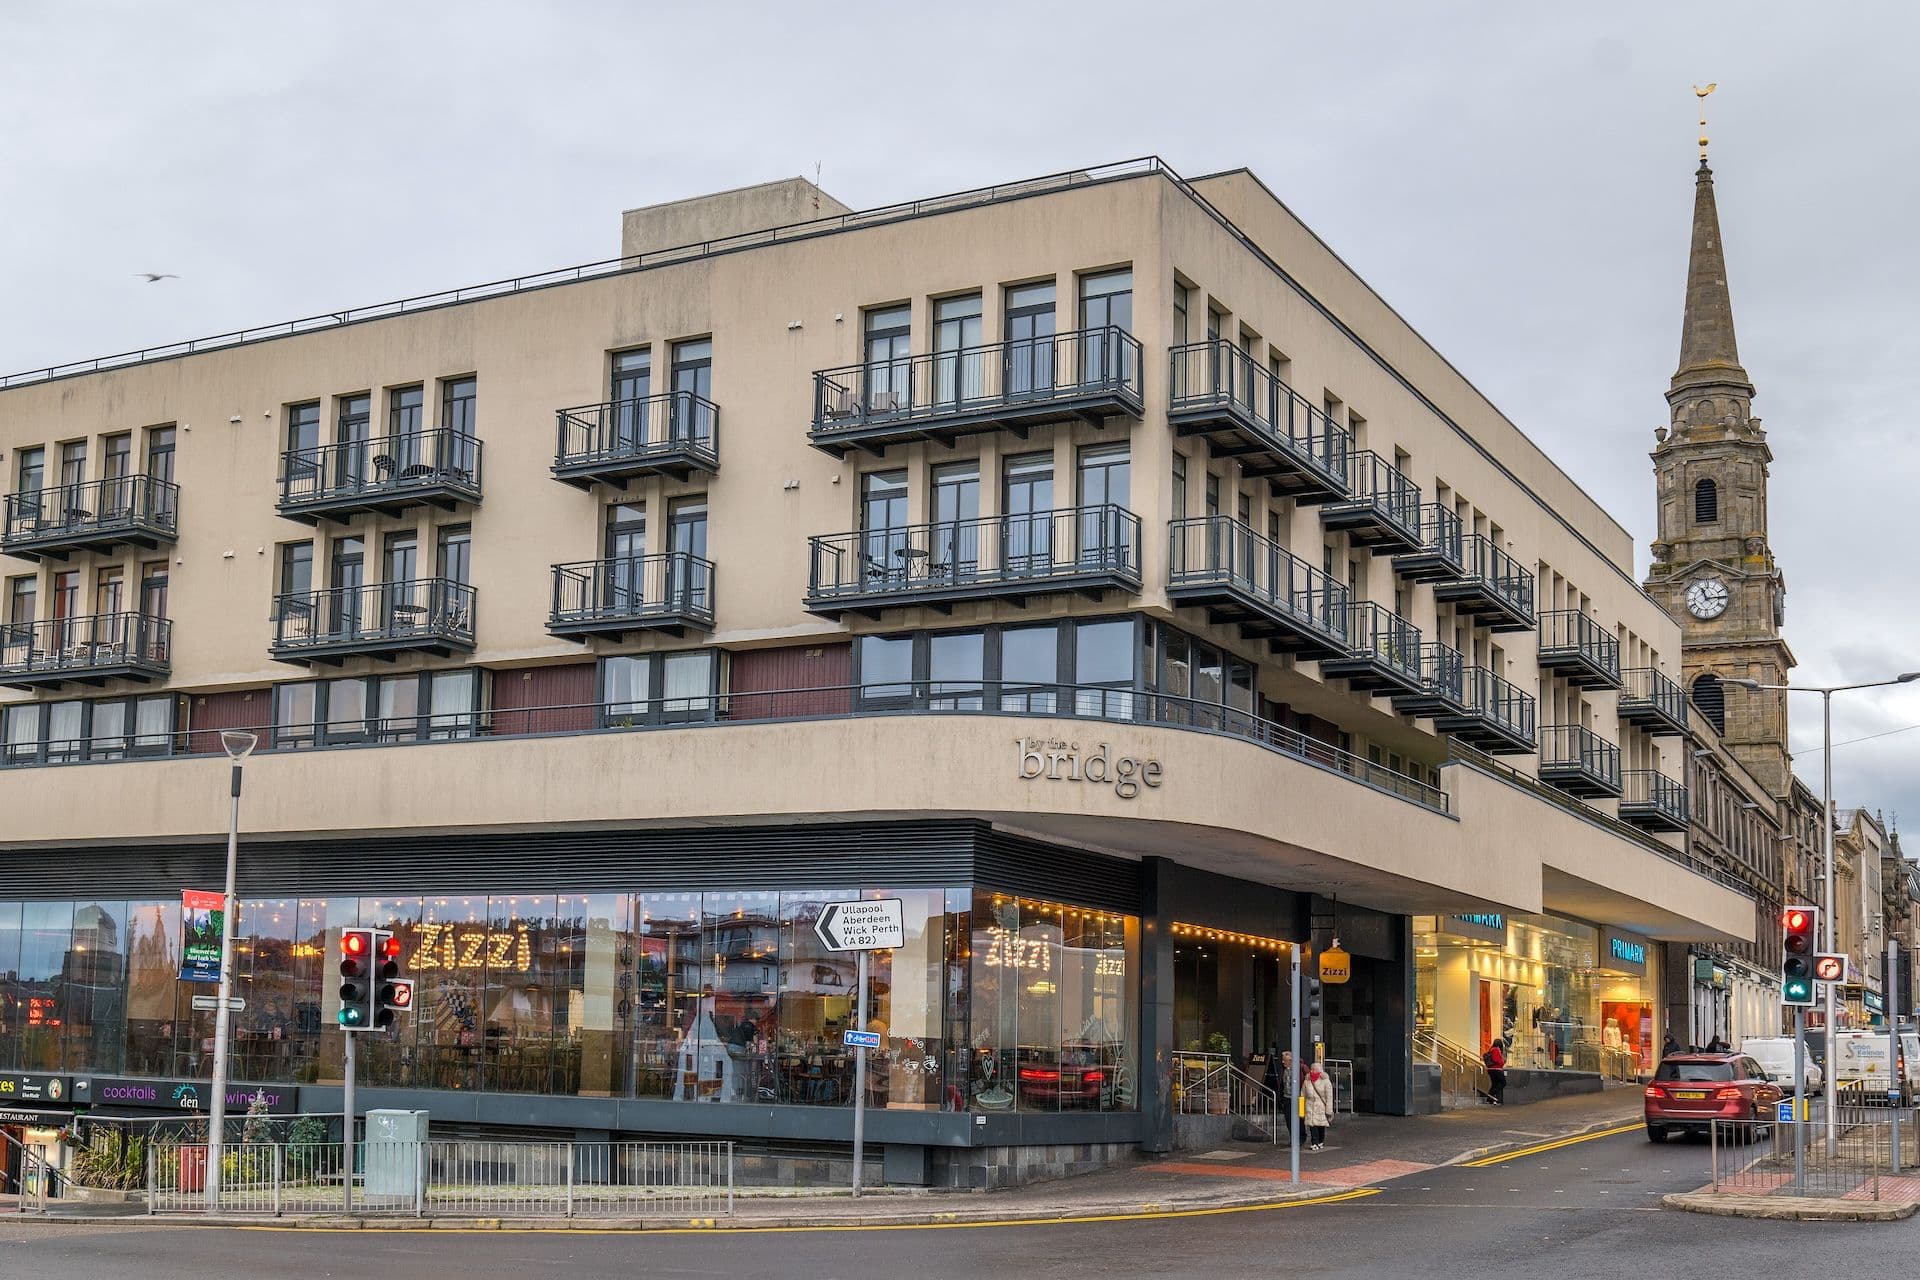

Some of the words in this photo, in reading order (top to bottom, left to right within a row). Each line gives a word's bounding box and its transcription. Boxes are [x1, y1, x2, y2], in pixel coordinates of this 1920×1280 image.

[1027, 736, 1044, 751] by
[1016, 737, 1164, 798] bridge
[842, 904, 883, 914] Ullapool
[843, 915, 891, 924] Aberdeen
[843, 926, 867, 935] Wick
[872, 924, 899, 934] Perth
[1611, 938, 1644, 964] PRIMARK
[103, 1086, 156, 1100] cocktails
[180, 1094, 198, 1108] den
